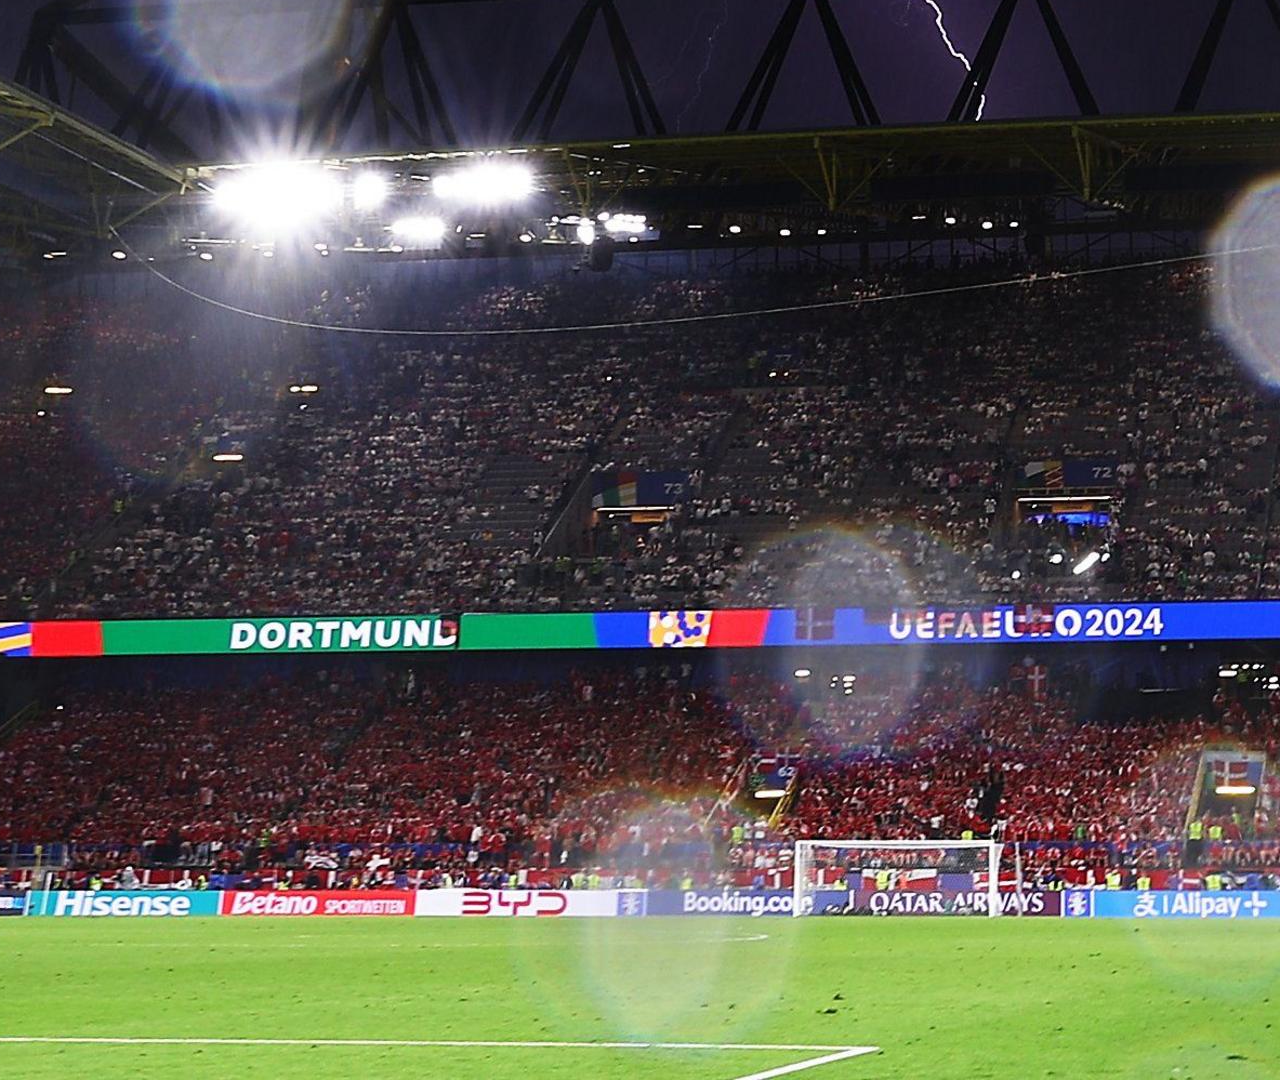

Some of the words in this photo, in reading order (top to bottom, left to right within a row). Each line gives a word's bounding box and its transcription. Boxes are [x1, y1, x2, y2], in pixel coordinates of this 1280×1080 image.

[1092, 467, 1113, 478] 72
[663, 482, 683, 495] 73
[778, 766, 796, 777] 62
[55, 891, 191, 916] Hisense
[232, 891, 316, 915] Betano
[323, 899, 406, 915] SPORTWETTEN
[462, 892, 567, 915] BYD
[870, 893, 944, 915] QATAR
[1172, 891, 1267, 917] Alipay+
